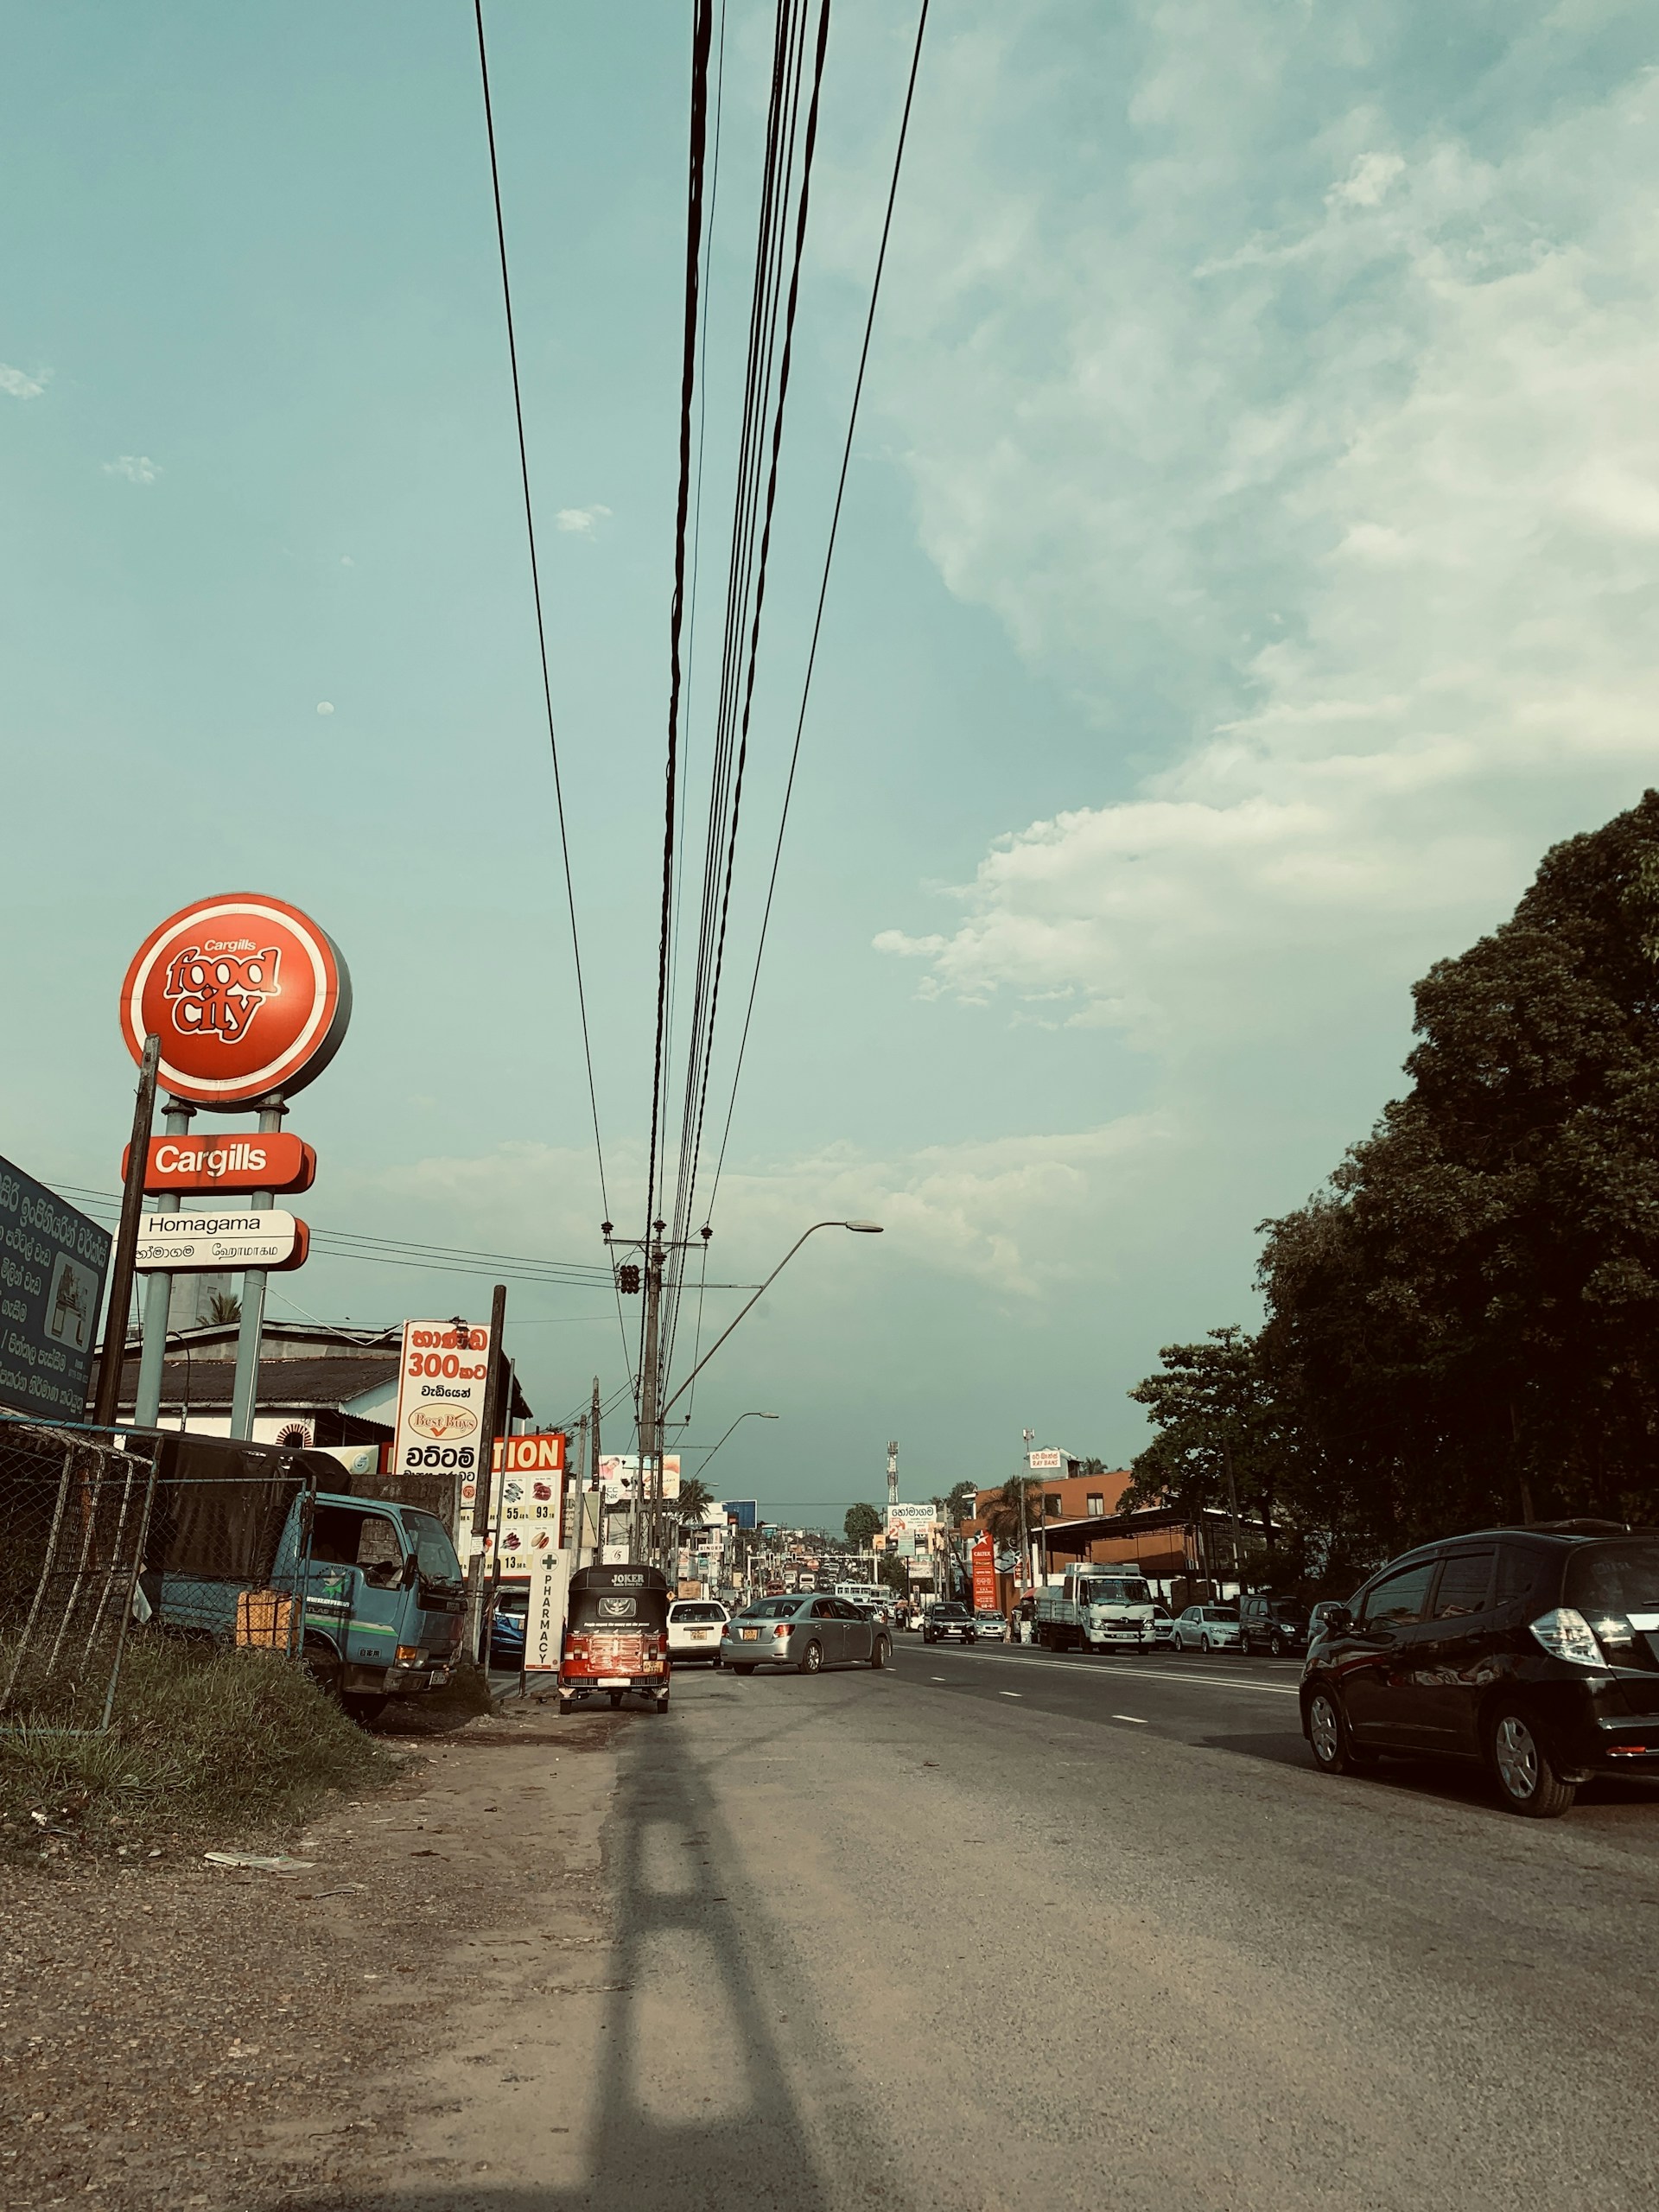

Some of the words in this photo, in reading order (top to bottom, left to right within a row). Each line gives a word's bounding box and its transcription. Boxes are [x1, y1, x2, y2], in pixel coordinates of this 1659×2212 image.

[203, 938, 257, 952] Cargills
[164, 946, 281, 998] food
[173, 988, 264, 1043] city
[155, 1143, 267, 1178] Cargills
[149, 1217, 260, 1234] Homagama
[212, 1243, 278, 1261] ஹோமாகம
[414, 1412, 443, 1427] Best
[444, 1414, 475, 1433] Buys
[611, 1574, 645, 1583] JOKER
[538, 1574, 552, 1664] PHARMACY
